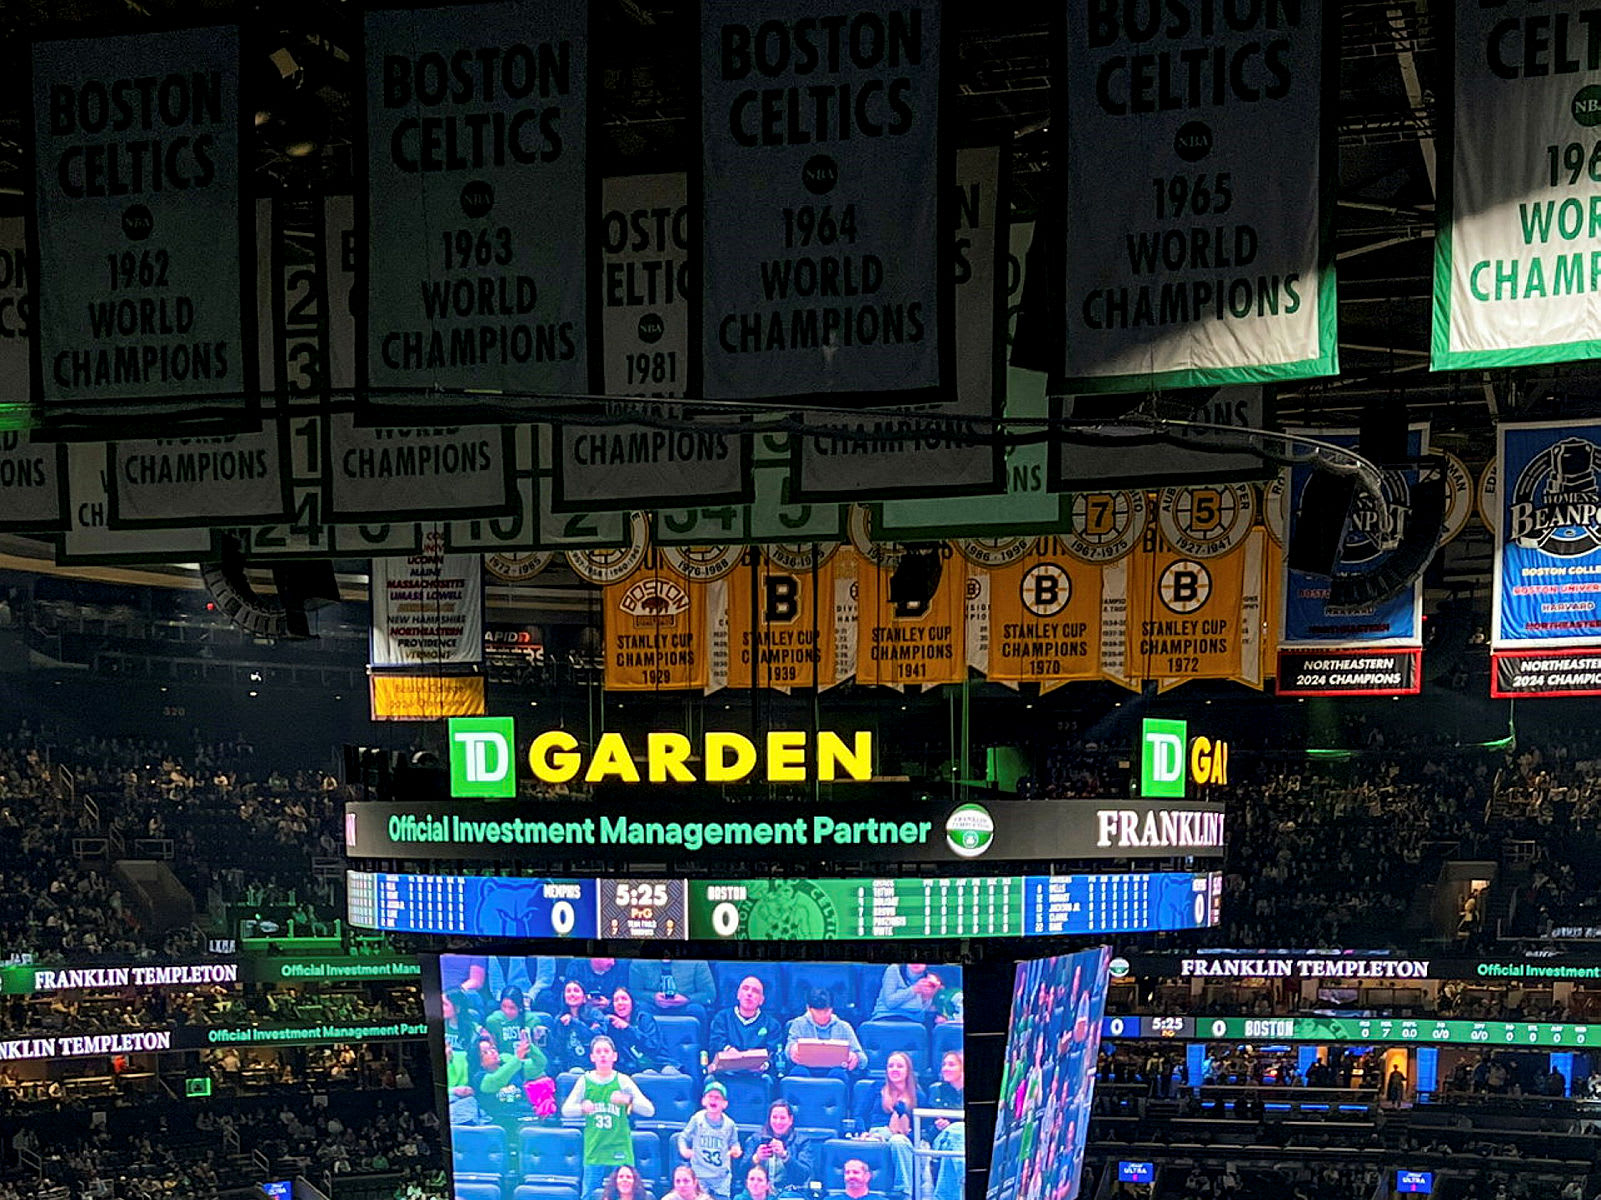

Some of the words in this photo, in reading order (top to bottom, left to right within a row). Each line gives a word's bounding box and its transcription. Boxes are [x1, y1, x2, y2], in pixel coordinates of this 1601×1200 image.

[721, 8, 921, 80] BOSTON
[383, 41, 570, 108] BOSTON
[1096, 39, 1292, 116] CELTICS
[51, 71, 222, 136] BOSTON
[729, 78, 912, 147] CELTICS
[391, 107, 562, 172] CELTICS
[1178, 135, 1209, 151] NBA
[58, 134, 214, 198] CELTICS
[1153, 172, 1232, 220] 1965
[783, 204, 857, 248] 1964
[443, 228, 512, 269] 1963
[1126, 225, 1258, 274] WORLD
[107, 250, 169, 290] 1962
[761, 255, 883, 300] WORLD
[421, 276, 537, 319] WORLD
[1082, 274, 1300, 330] CHAMPIONS
[90, 297, 194, 338] WORLD
[719, 302, 924, 353] CHAMPIONS
[381, 322, 575, 370] CHAMPIONS
[54, 341, 227, 387] CHAMPIONS
[626, 352, 677, 384] 1981
[343, 440, 491, 479] CHAMPIONS
[574, 432, 728, 466] CHAMPIONS
[125, 449, 267, 485] CHAMPIONS
[1090, 500, 1110, 528] 7
[1195, 501, 1214, 524] 5
[1522, 567, 1566, 577] BOSTON
[620, 578, 689, 612] BOSTON
[1035, 575, 1058, 605] B
[1173, 571, 1199, 602] B
[764, 575, 800, 623] B
[1541, 602, 1596, 612] HARVARD
[743, 631, 793, 646] SANLEY
[872, 627, 925, 642] STANLEY
[929, 626, 951, 640] CUP
[1004, 624, 1058, 638] STANLEY
[1063, 623, 1087, 637] CUP
[1142, 621, 1198, 636] STANLEY
[1202, 620, 1227, 635] CUP
[398, 639, 456, 647] PROVIDENCE
[618, 635, 668, 649] STANLEY
[672, 633, 693, 647] CUP
[871, 645, 953, 660] CHAMPIONS
[1002, 642, 1087, 657] CHAMPIONS
[1141, 639, 1227, 655] CHAMPIONS
[616, 651, 694, 666] CHAMPIONS
[742, 650, 821, 664] CAMPIONS
[1030, 660, 1060, 674] 1970
[1168, 658, 1198, 672] 1972
[1304, 659, 1394, 671] NORTHEASTERN
[643, 670, 671, 684] 1929
[769, 667, 796, 680] 1939
[899, 664, 926, 678] 1941
[1297, 675, 1326, 686] 2024
[1329, 673, 1401, 686] CHAMPIONS
[1513, 676, 1545, 687] 2024
[454, 732, 509, 782] TD
[529, 730, 873, 784] GARDEN
[1146, 733, 1183, 782] TD
[388, 814, 449, 844] Official
[453, 816, 595, 844] Investment
[601, 817, 808, 850] Management
[814, 814, 932, 844] Partner
[1097, 810, 1225, 847] FRANKLIN
[543, 884, 581, 899] MEMPHIS
[615, 884, 669, 907] 5:25
[707, 885, 748, 901] BOSTON
[552, 901, 575, 933] 0
[712, 902, 740, 936] 0
[35, 968, 129, 990] FRANKLIN
[132, 965, 237, 986] TEMPLETON
[281, 964, 324, 977] Official
[327, 963, 391, 976] Investment
[1181, 959, 1294, 977] FRANKLIN
[1297, 960, 1430, 978] TEMPLETON
[1477, 963, 1525, 976] Official
[1526, 964, 1600, 978] Investment
[209, 1028, 251, 1042] Official
[253, 1027, 320, 1040] Investment
[322, 1025, 399, 1039] Management
[1111, 1019, 1123, 1034] 0
[1152, 1017, 1183, 1030] 5:25
[1212, 1021, 1226, 1037] 0
[1245, 1020, 1294, 1037] BOSTON
[59, 1031, 171, 1055] TEMPLETON
[595, 1115, 613, 1129] 33
[702, 1150, 722, 1166] 33
